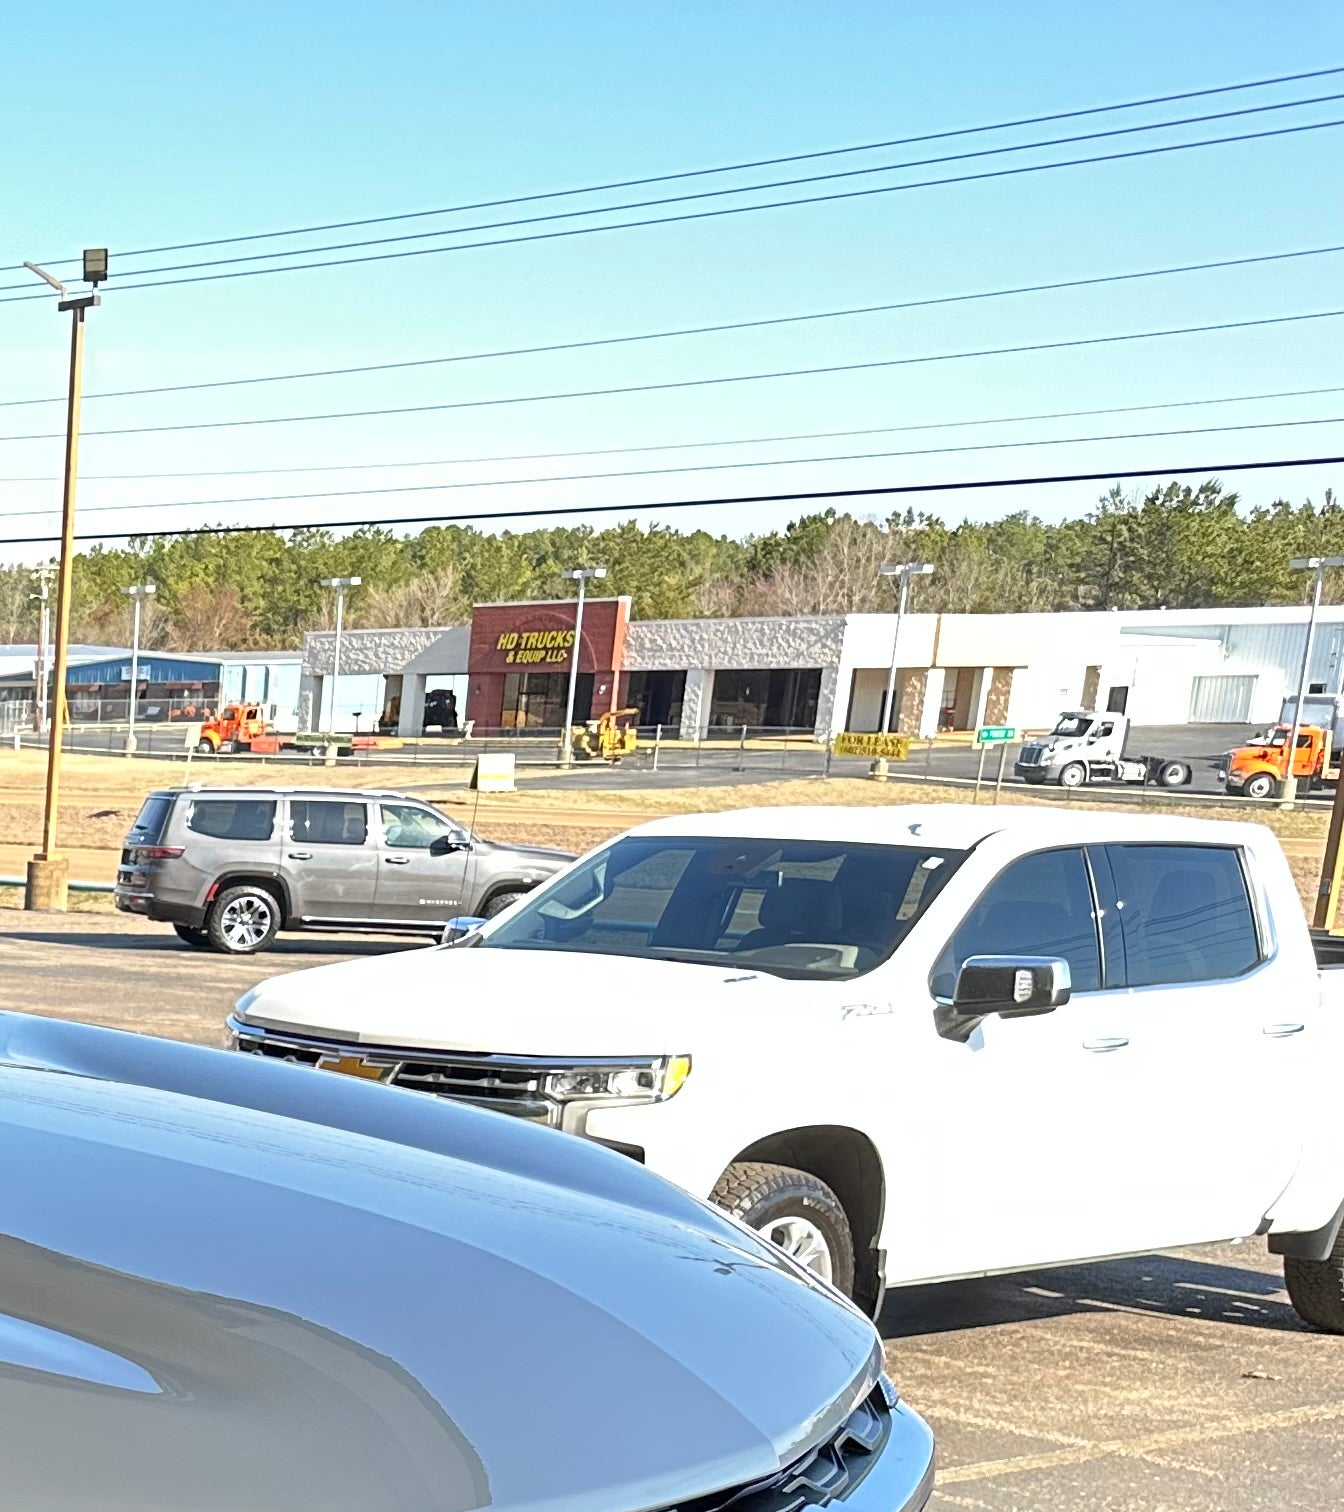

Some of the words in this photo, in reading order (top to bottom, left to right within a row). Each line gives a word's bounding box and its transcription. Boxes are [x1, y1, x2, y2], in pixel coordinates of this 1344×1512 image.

[497, 632, 518, 649] HD
[520, 630, 575, 649] TRUCKS
[505, 650, 515, 663] &
[515, 649, 546, 664] EQUIP
[546, 648, 565, 663] LLC
[842, 735, 863, 746] FOR
[867, 736, 903, 748] LEASE
